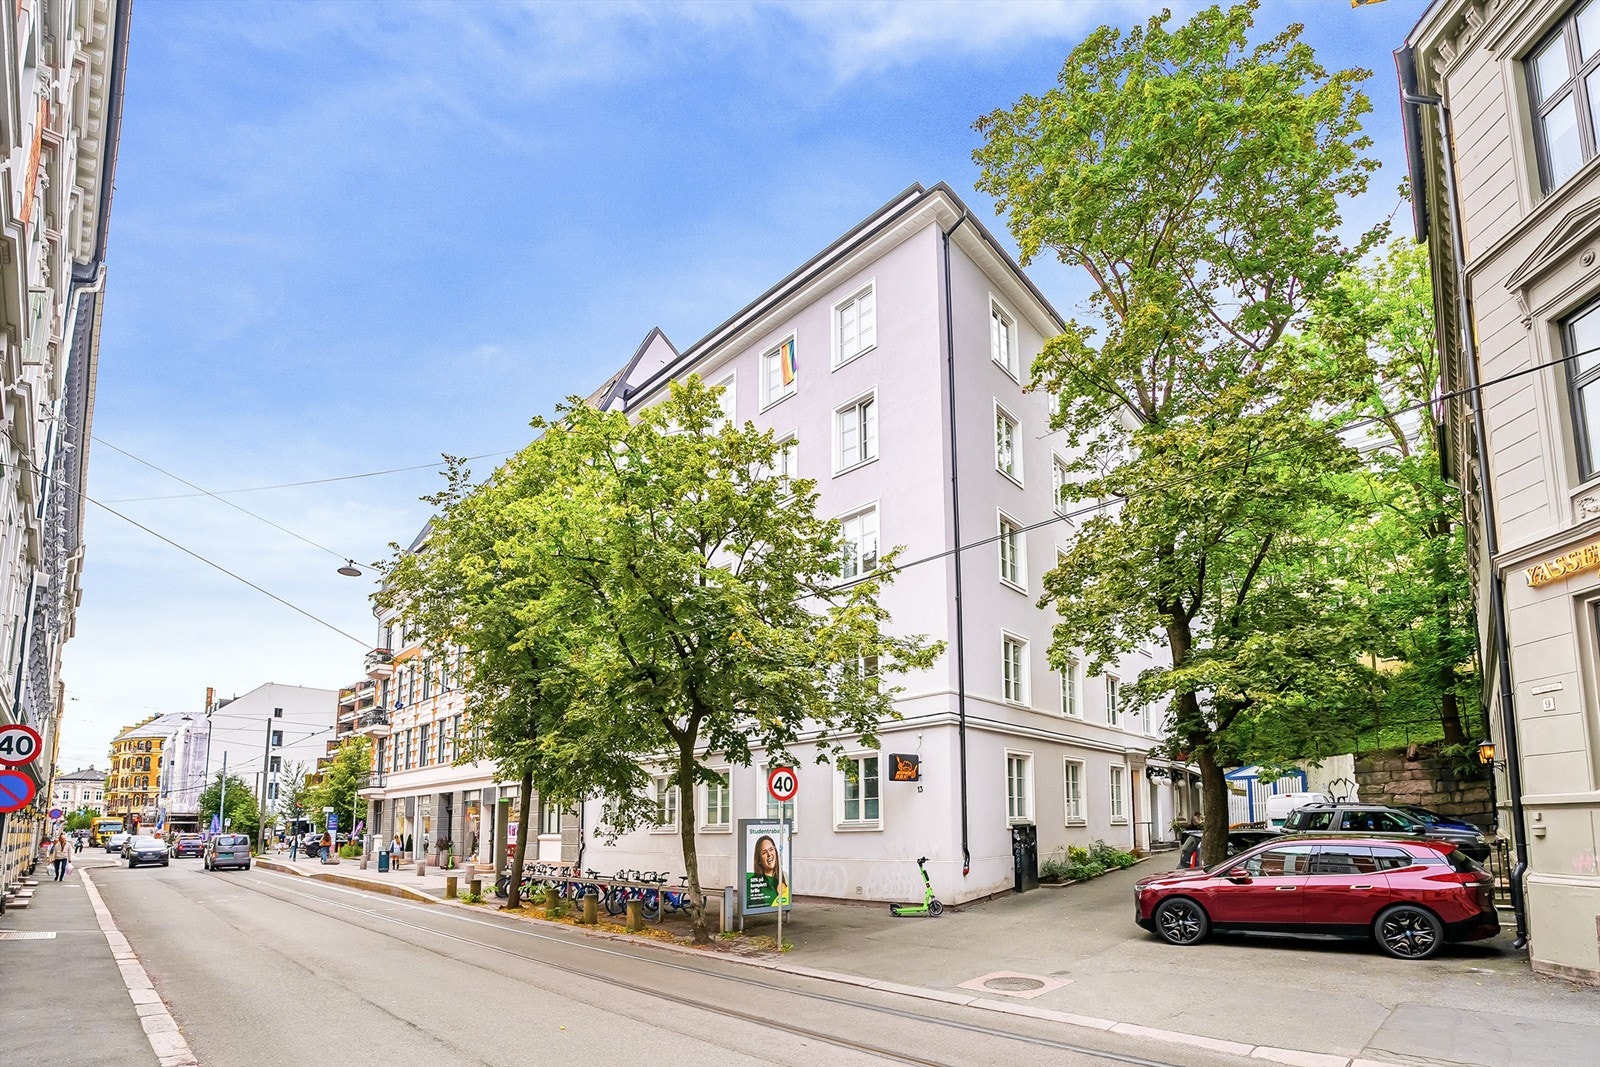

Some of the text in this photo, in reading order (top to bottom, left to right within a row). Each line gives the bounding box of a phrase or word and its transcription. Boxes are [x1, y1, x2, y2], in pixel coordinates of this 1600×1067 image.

[1524, 542, 1600, 586] YASSE
[0, 736, 33, 755] 40
[774, 776, 793, 792] 40
